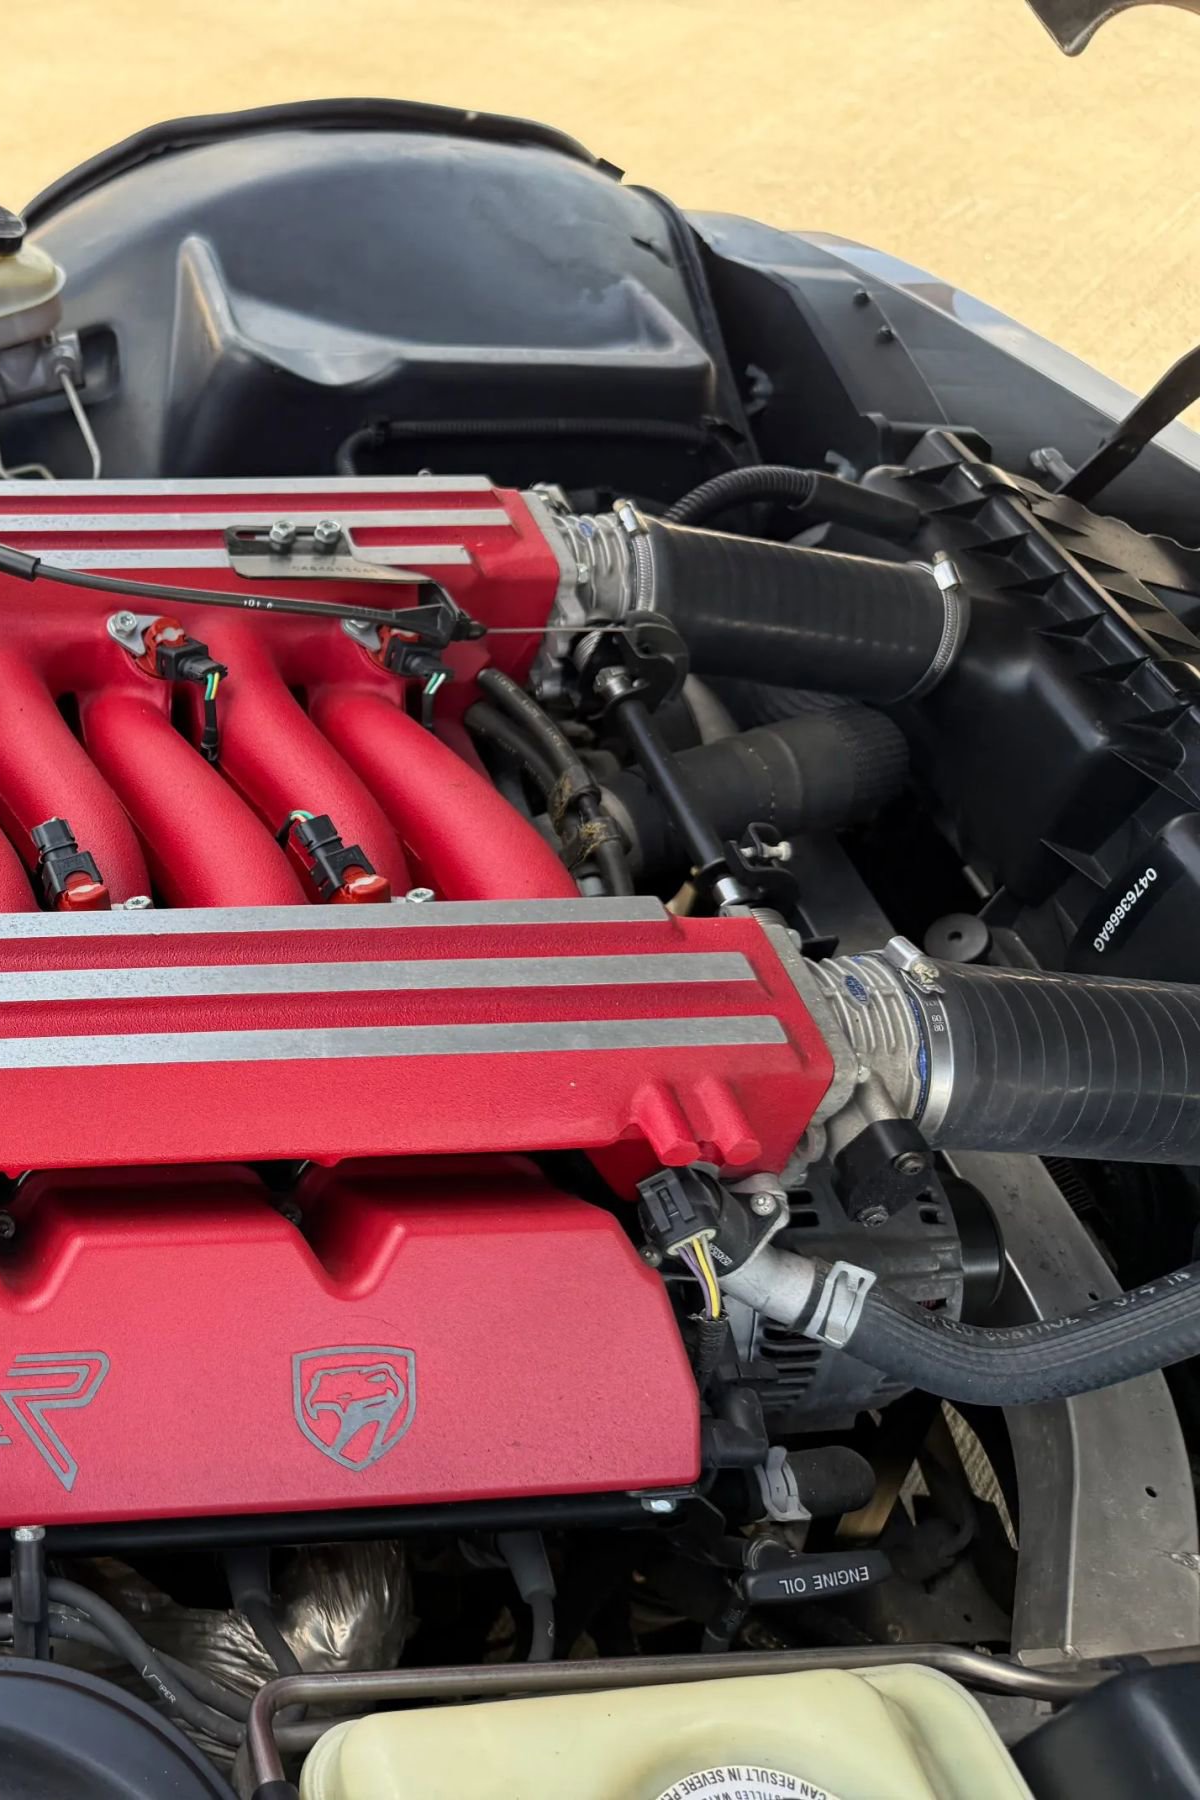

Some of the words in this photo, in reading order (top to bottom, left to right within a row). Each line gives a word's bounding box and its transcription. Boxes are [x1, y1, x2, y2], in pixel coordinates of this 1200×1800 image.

[1093, 868, 1157, 952] 04763666AG
[779, 1577, 806, 1595] OIL
[813, 1566, 870, 1590] ENGINE
[679, 1768, 724, 1793] SEVERE
[727, 1767, 741, 1781] IN
[745, 1767, 796, 1790] RESULT
[800, 1783, 826, 1800] CAN
